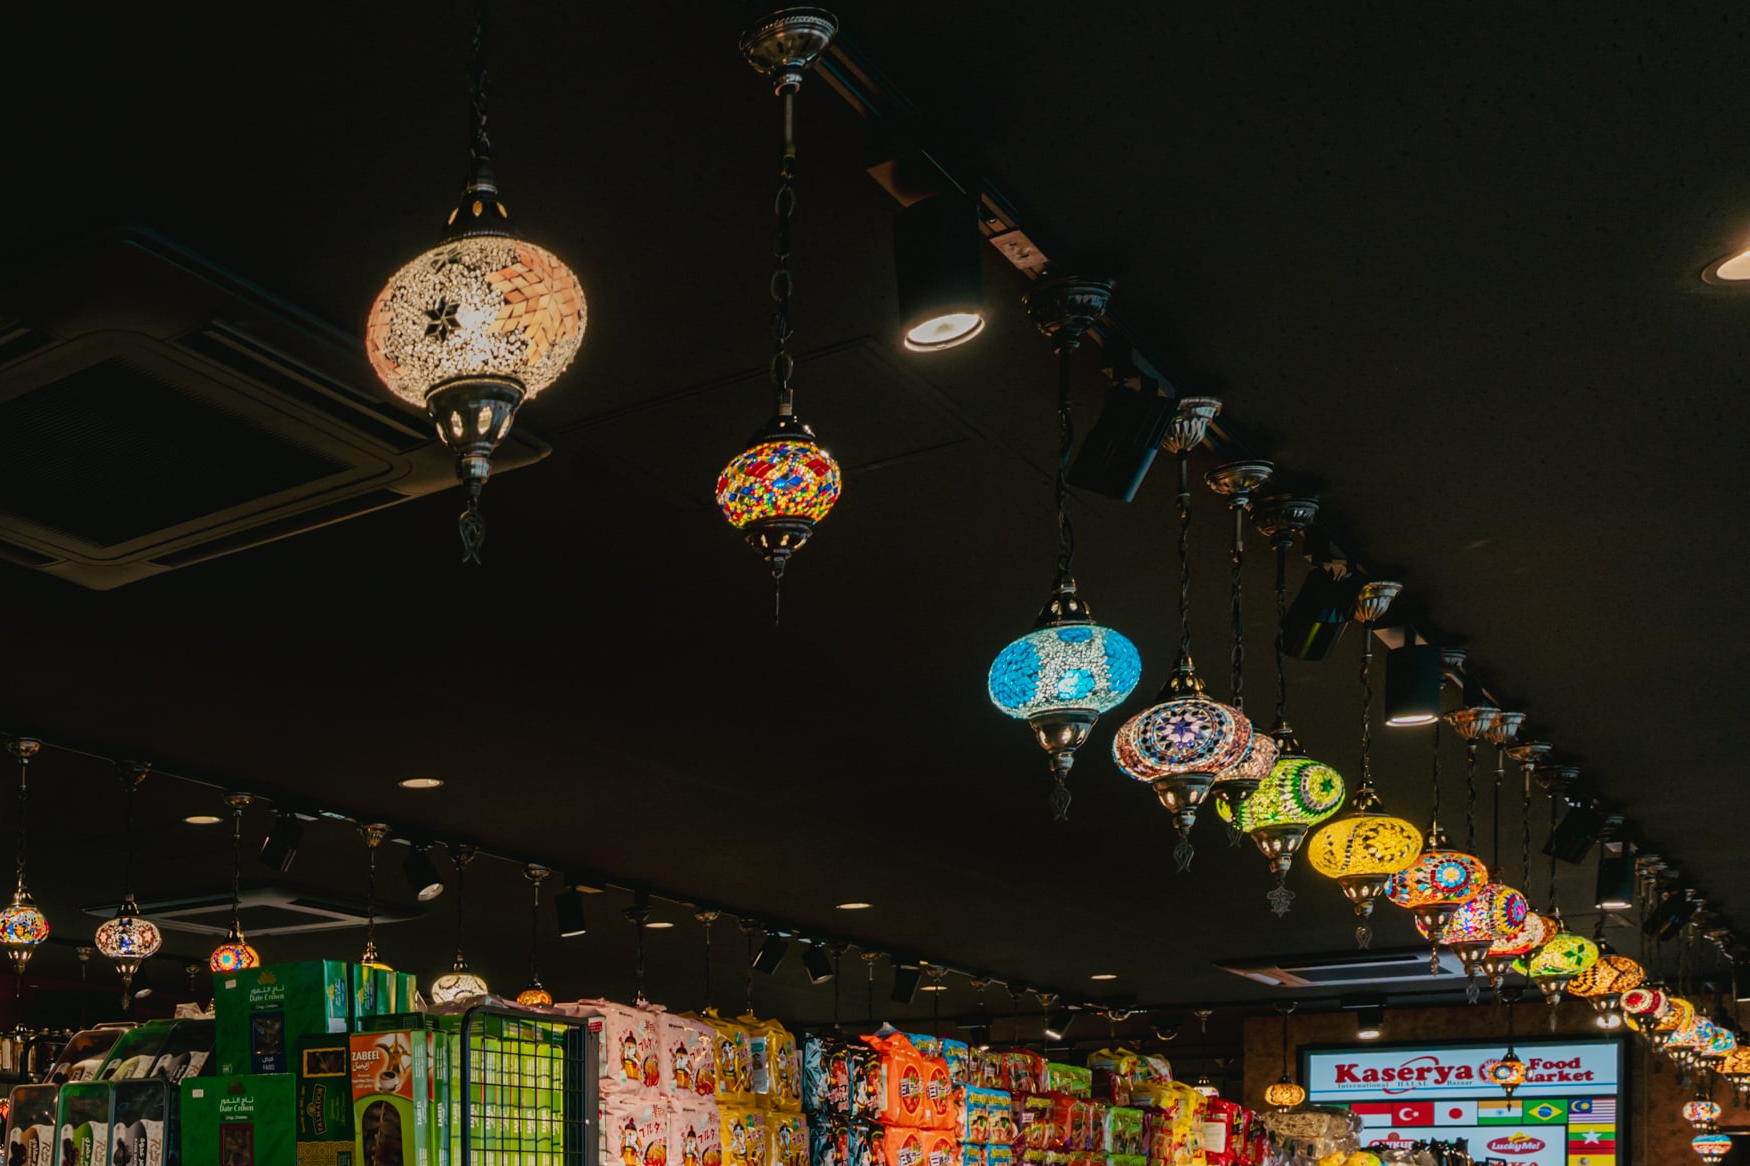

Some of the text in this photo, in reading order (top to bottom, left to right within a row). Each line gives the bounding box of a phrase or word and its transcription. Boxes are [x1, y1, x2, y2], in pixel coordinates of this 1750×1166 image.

[351, 1051, 380, 1062] ZABEEL
[1529, 1057, 1581, 1070] Food
[1335, 1063, 1474, 1086] Kaserya
[234, 1104, 254, 1112] Crown
